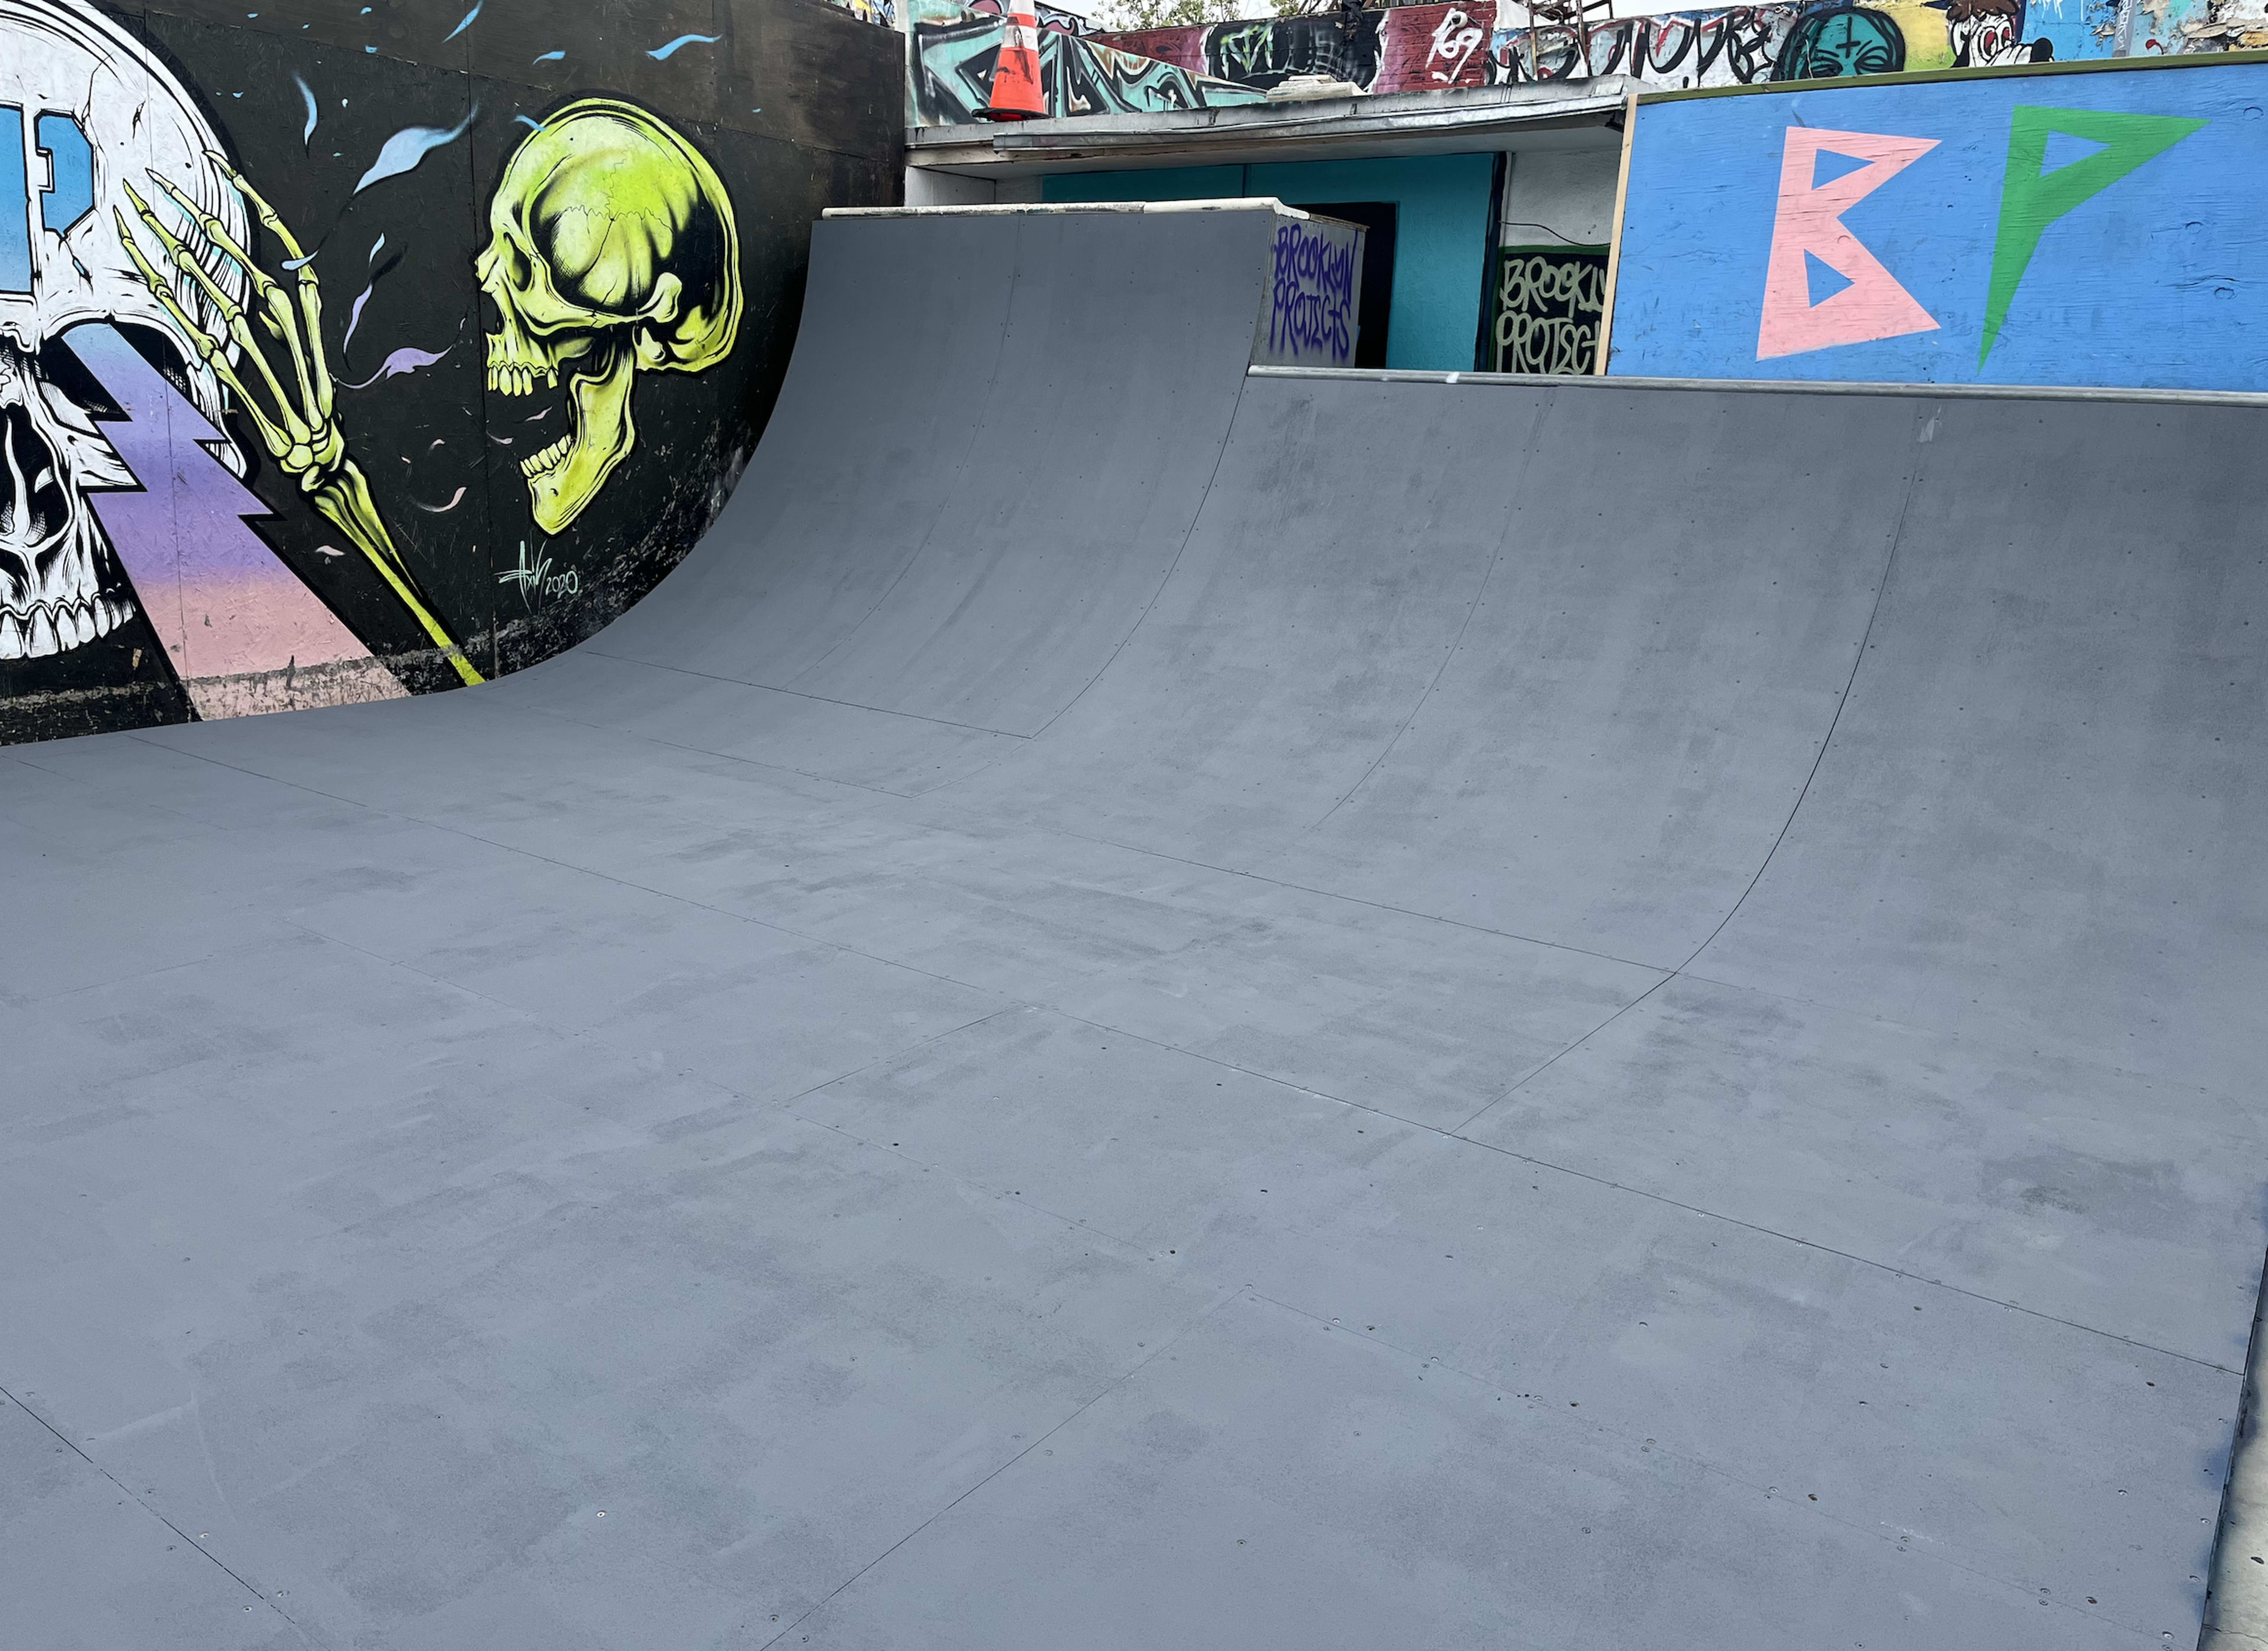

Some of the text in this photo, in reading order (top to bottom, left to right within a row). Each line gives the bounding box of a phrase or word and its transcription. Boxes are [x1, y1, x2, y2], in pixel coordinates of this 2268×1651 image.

[1271, 223, 1358, 307] BROOKLYN
[1270, 277, 1351, 362] PROJECTS
[545, 570, 578, 599] 2020
